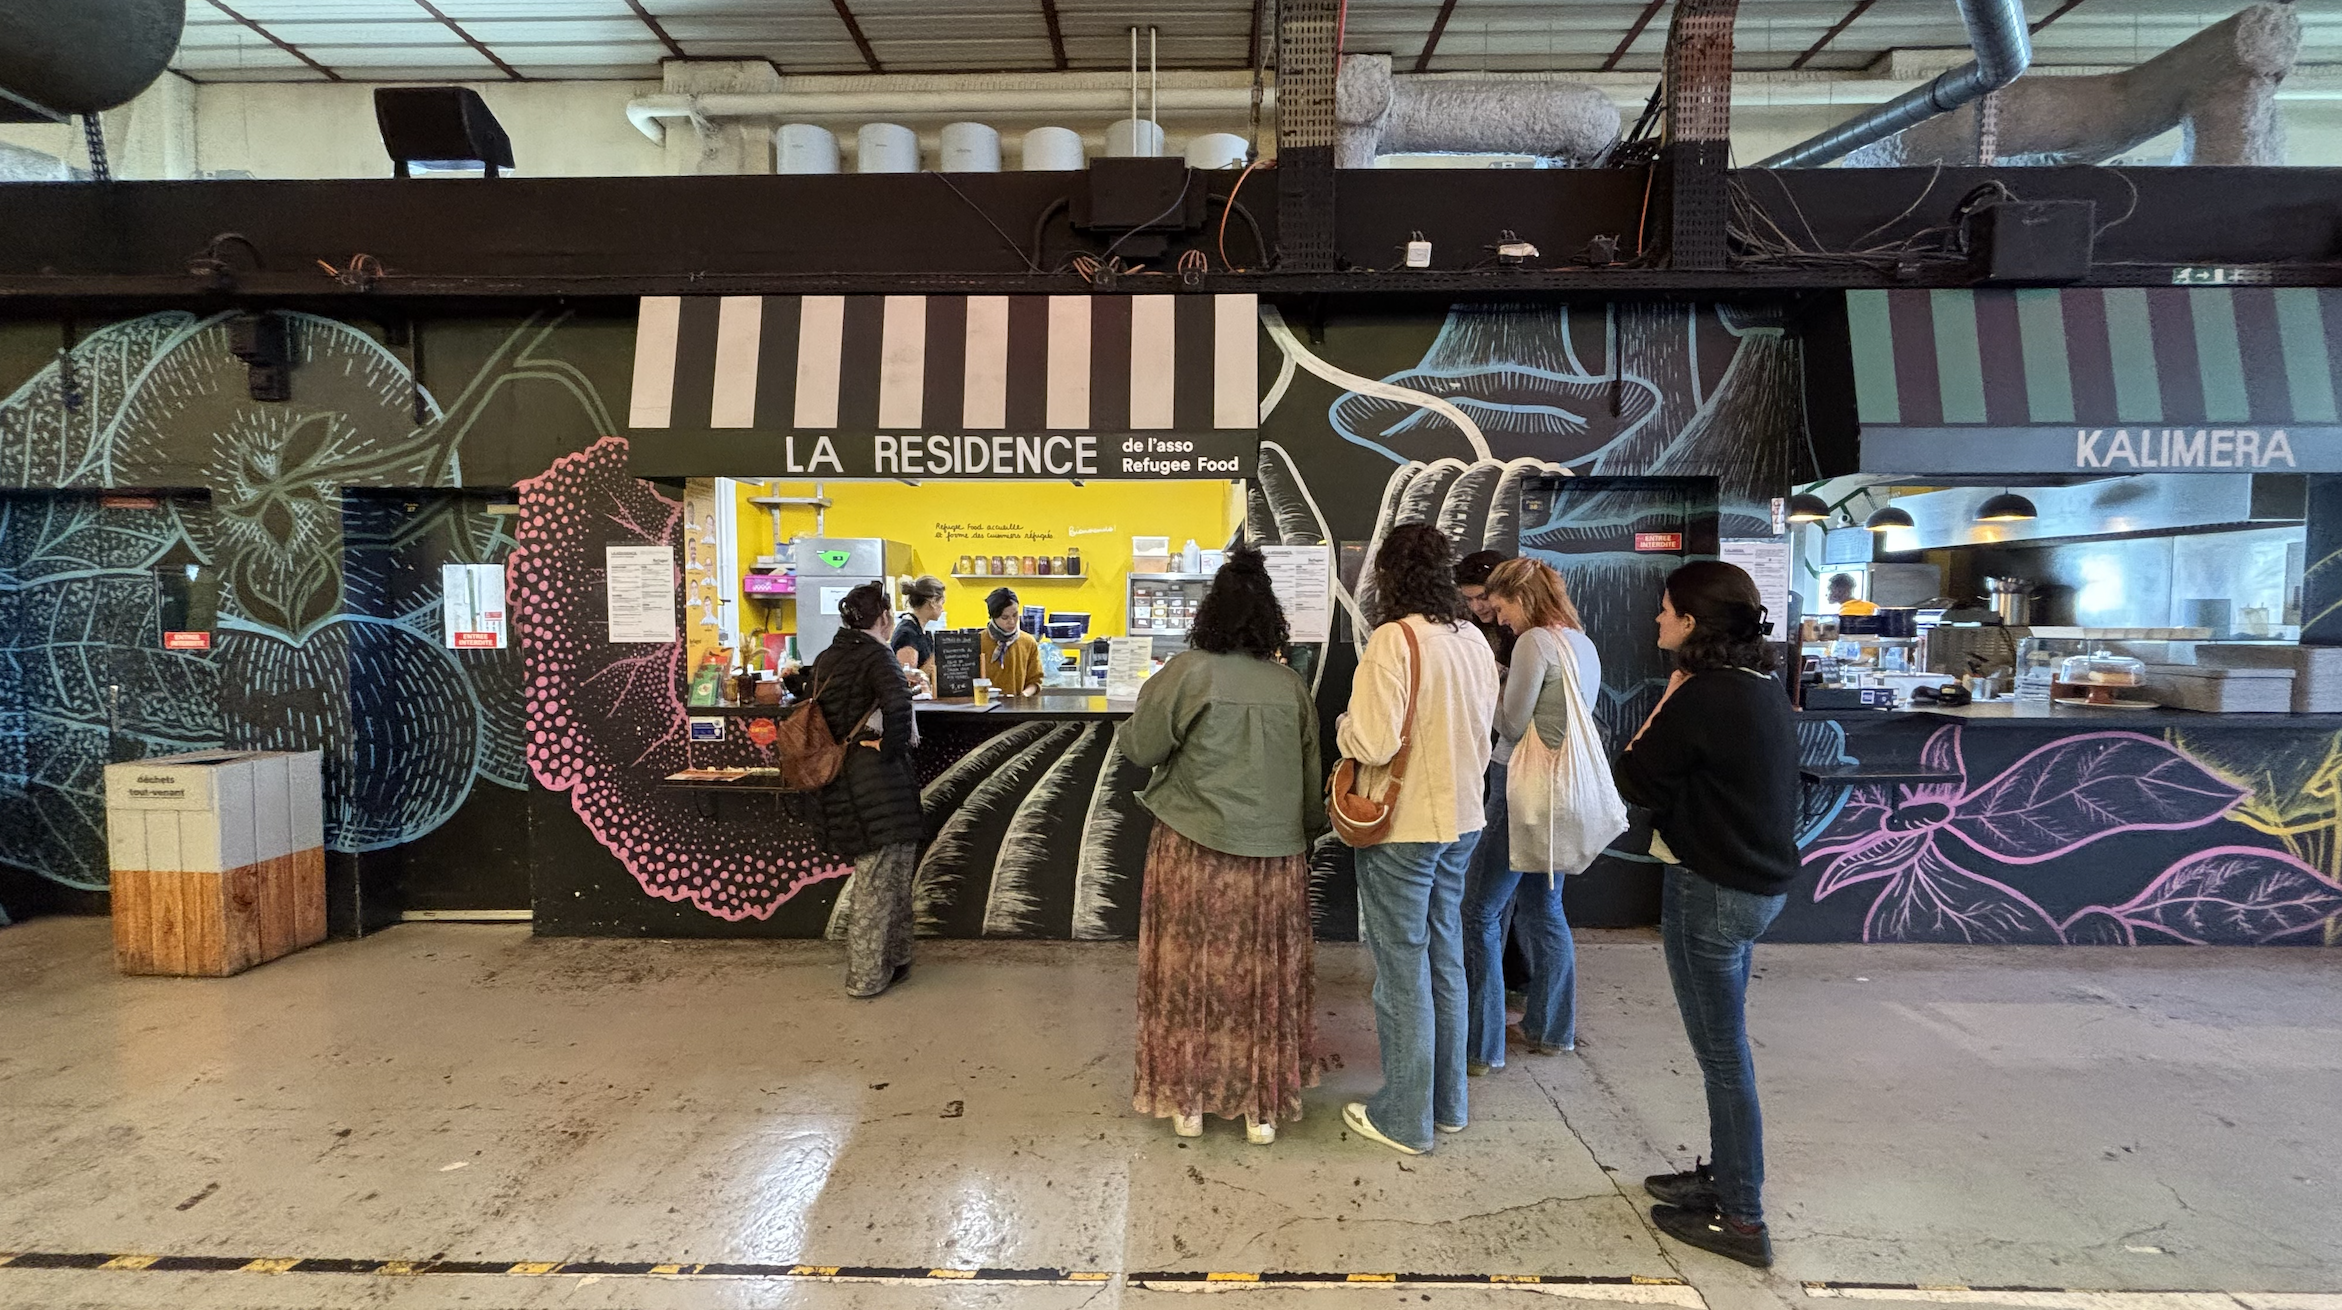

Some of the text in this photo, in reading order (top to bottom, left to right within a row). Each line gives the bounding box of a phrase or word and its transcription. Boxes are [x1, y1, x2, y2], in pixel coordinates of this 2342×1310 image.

[1122, 437, 1144, 453] de
[2076, 429, 2297, 468] KALIMERA
[785, 435, 1098, 475] LA RESIDENCE
[1122, 456, 1240, 475] Refugee Food
[935, 522, 964, 533] Refugee
[986, 522, 1024, 531] accueille
[946, 532, 968, 542] forme
